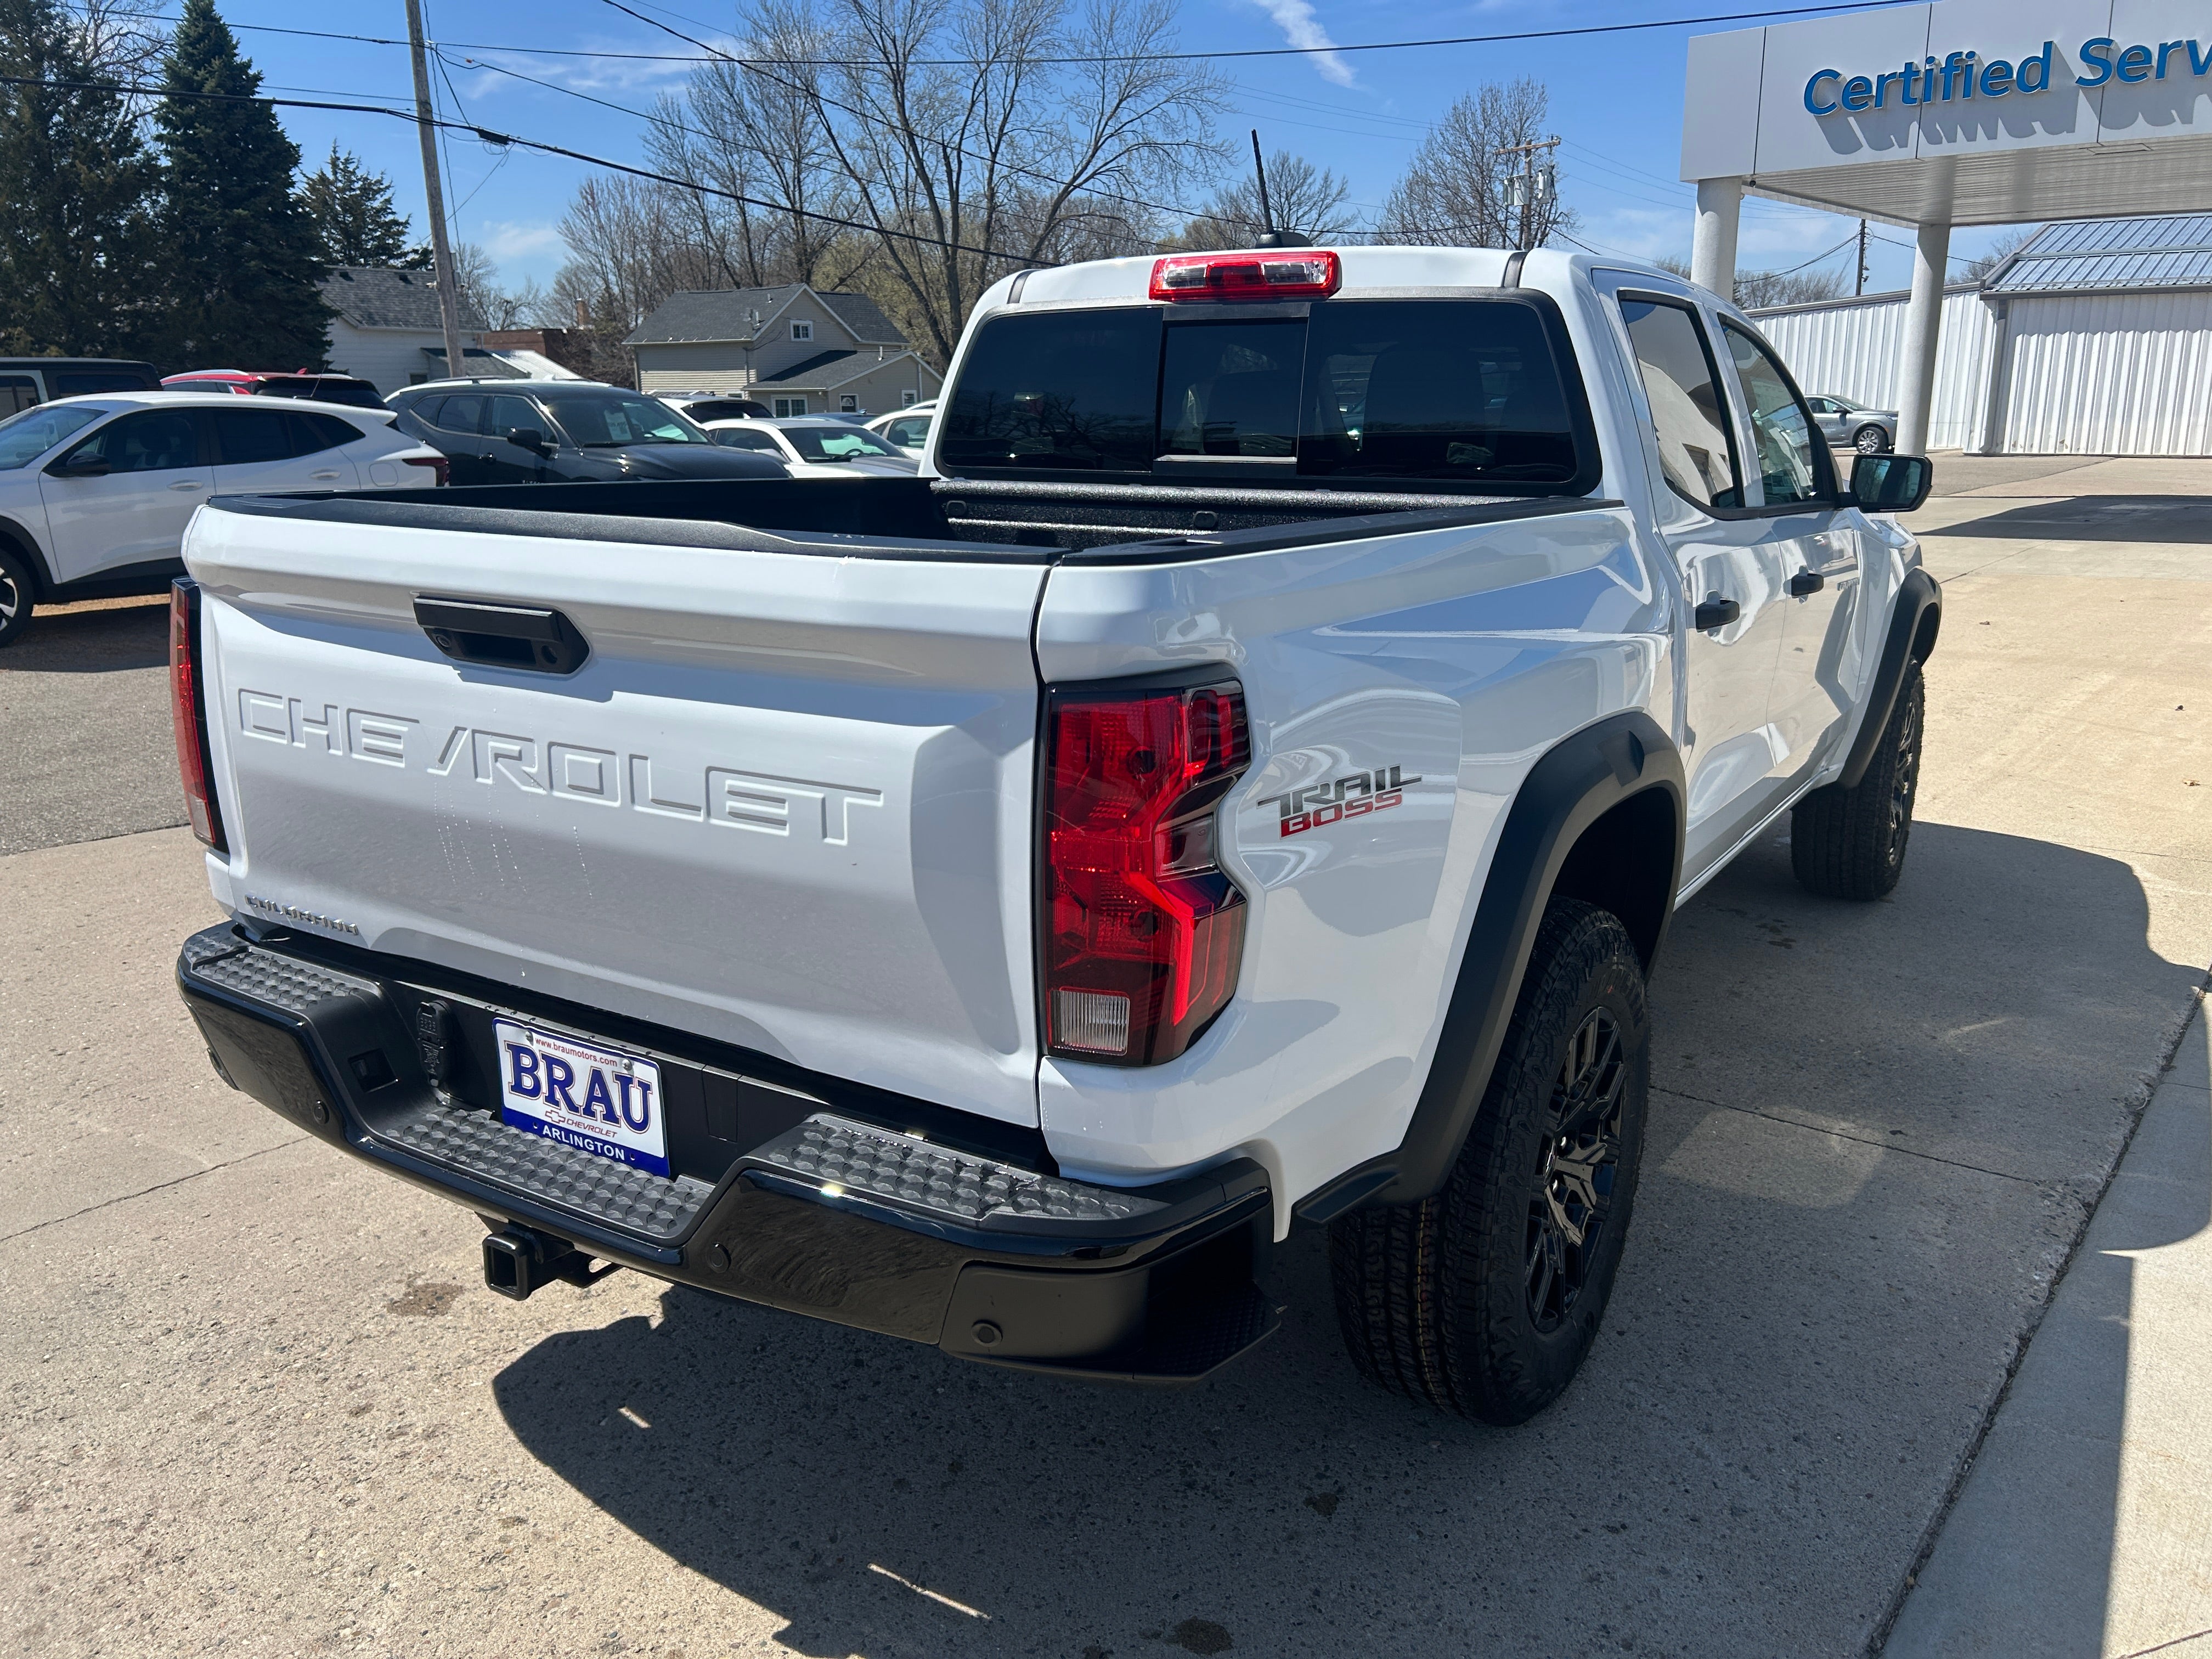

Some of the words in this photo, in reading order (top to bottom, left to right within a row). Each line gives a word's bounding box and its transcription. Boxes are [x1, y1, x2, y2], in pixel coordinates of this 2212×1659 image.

[1804, 41, 2056, 116] Certified
[239, 689, 883, 845] CHEVROLET
[1257, 764, 1422, 818] TRAIL
[1280, 788, 1402, 839] BOSS
[535, 1039, 618, 1066] www.braumotors.com
[504, 1040, 653, 1134] BRAU
[543, 1125, 625, 1160] ARLINGTON
[566, 1118, 617, 1138] CHEVROLET
